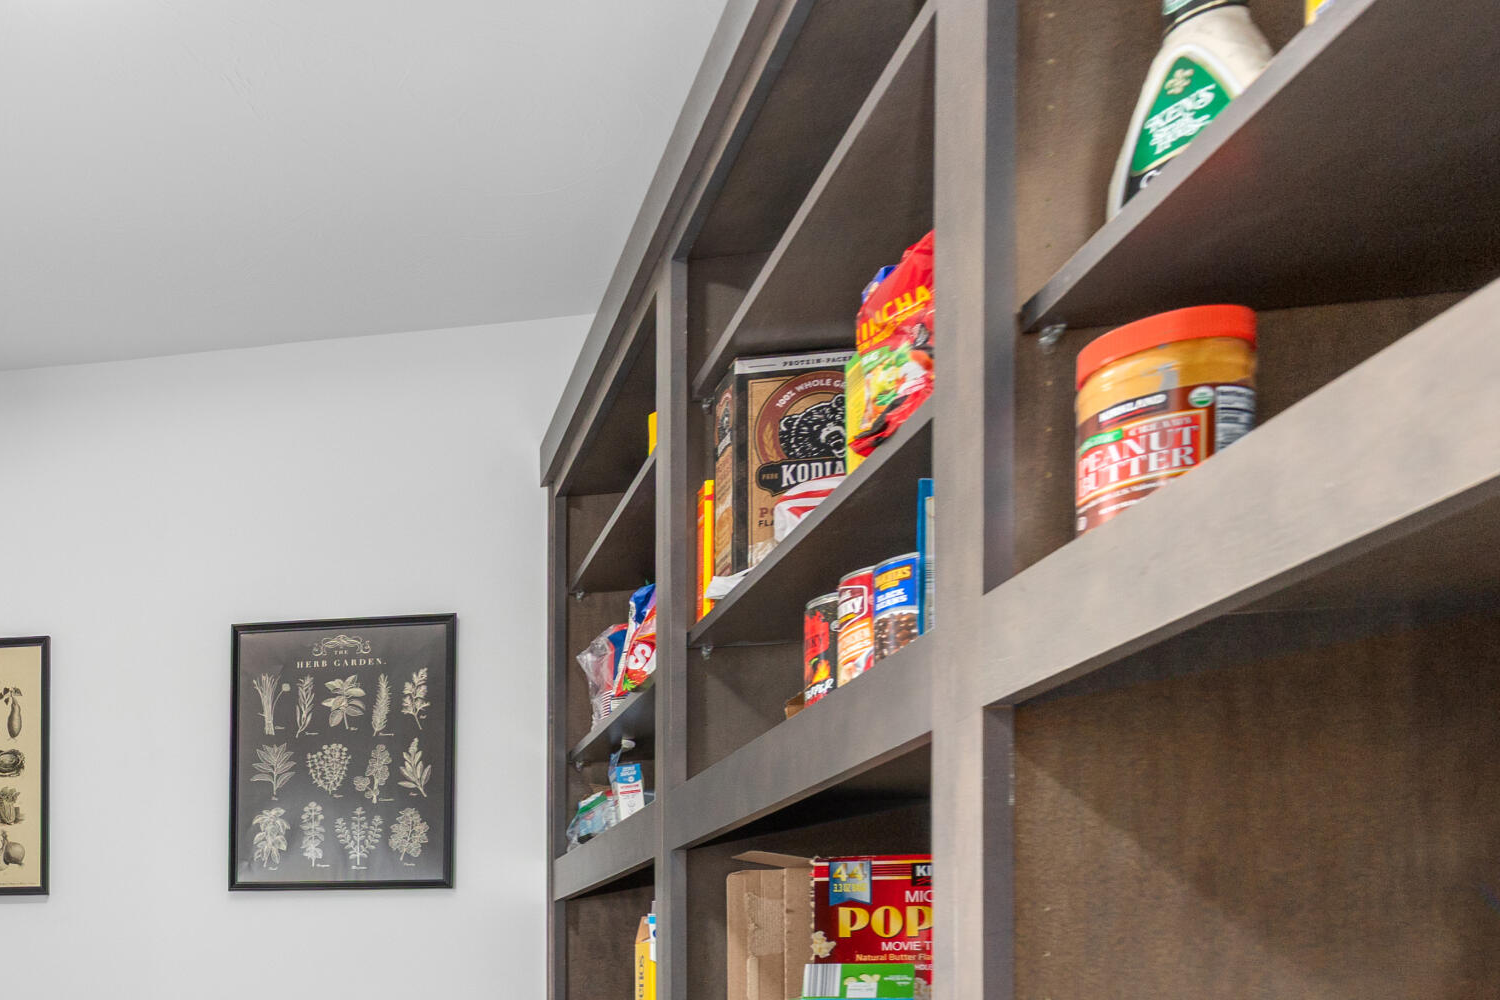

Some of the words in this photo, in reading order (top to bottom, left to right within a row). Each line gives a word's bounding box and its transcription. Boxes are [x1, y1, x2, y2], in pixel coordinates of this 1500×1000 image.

[795, 378, 832, 393] WHOLE
[1079, 424, 1200, 478] PEANUT
[1078, 445, 1196, 498] BUTTER
[296, 660, 328, 669] HERB
[832, 863, 867, 881] 44
[881, 941, 921, 951] MOVIE
[855, 953, 887, 962] Natural
[889, 953, 916, 961] Butter
